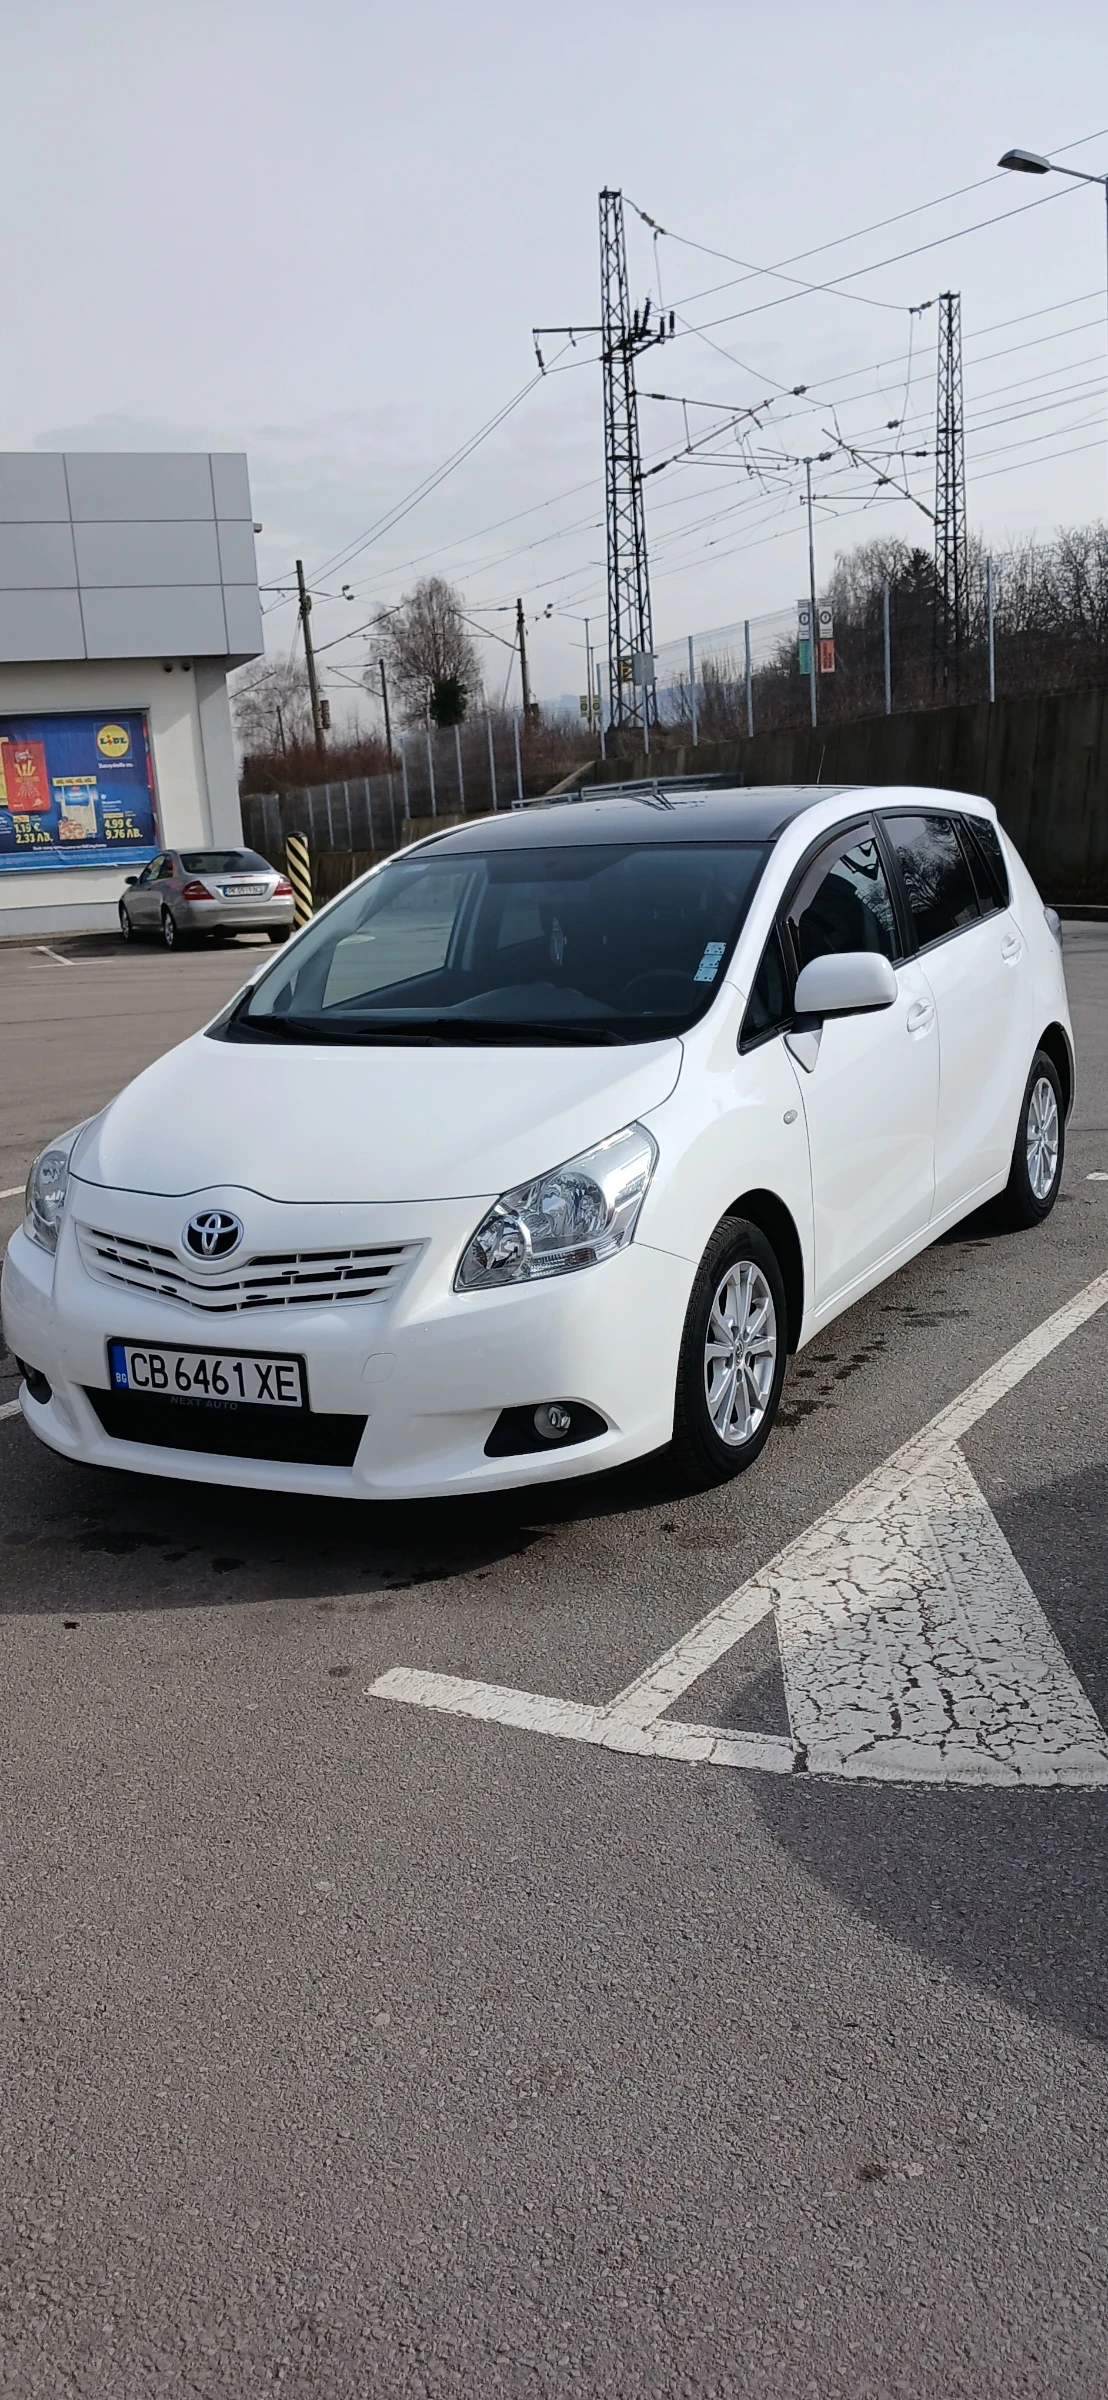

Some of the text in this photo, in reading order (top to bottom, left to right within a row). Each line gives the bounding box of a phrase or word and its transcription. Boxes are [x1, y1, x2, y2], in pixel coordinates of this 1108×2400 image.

[13, 823, 31, 833] 1.19
[34, 822, 41, 832] €
[104, 818, 133, 829] 4.99 €
[15, 833, 36, 844] 2.33
[105, 829, 125, 839] 9.76
[115, 1372, 127, 1383] BG
[130, 1352, 298, 1402] CB 6461 XE
[170, 1396, 238, 1411] NEXT AUTO
